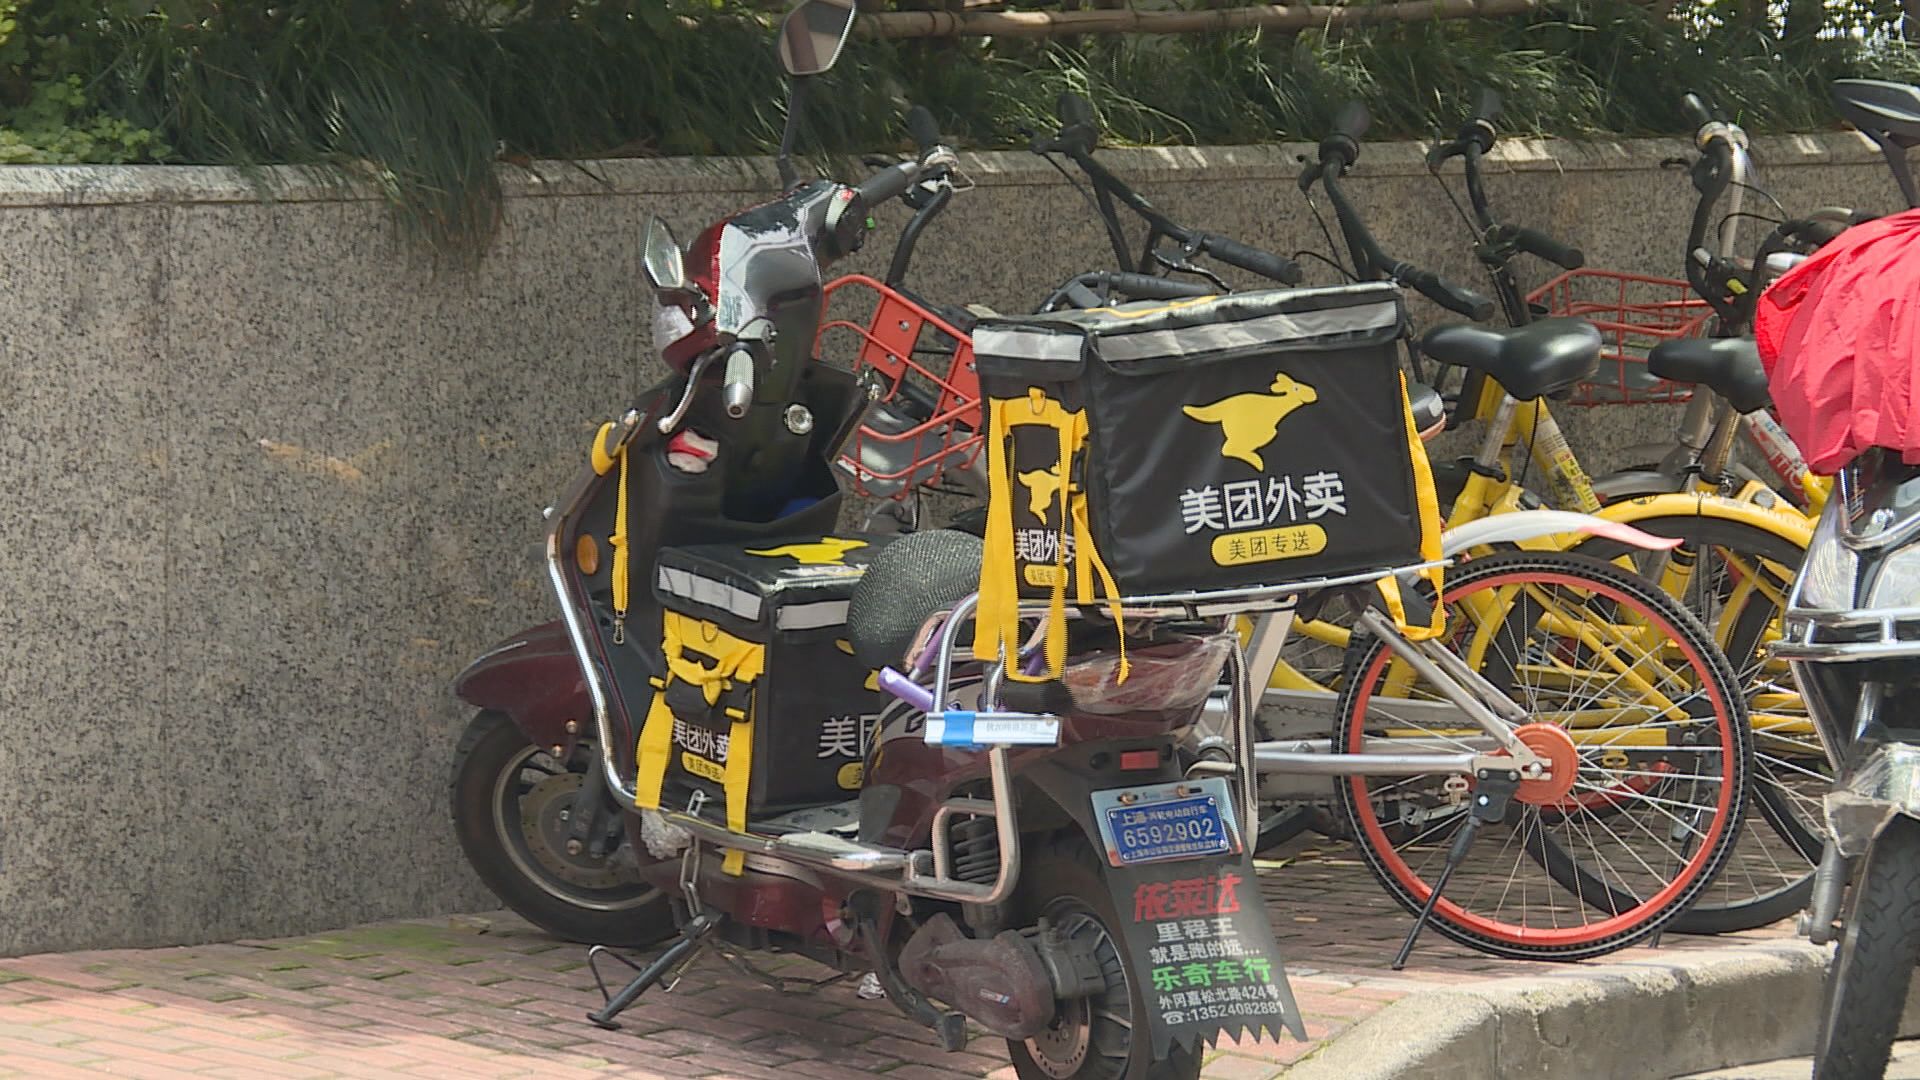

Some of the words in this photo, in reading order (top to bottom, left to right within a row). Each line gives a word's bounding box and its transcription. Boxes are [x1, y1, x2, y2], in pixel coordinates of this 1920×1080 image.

[1180, 471, 1347, 534] 美团外卖
[1229, 530, 1311, 561] 美团专送
[1124, 818, 1217, 848] 6592902
[1134, 872, 1243, 922] 依莱达
[1156, 917, 1238, 943] 里程王
[1152, 958, 1272, 992] 乐奇车行
